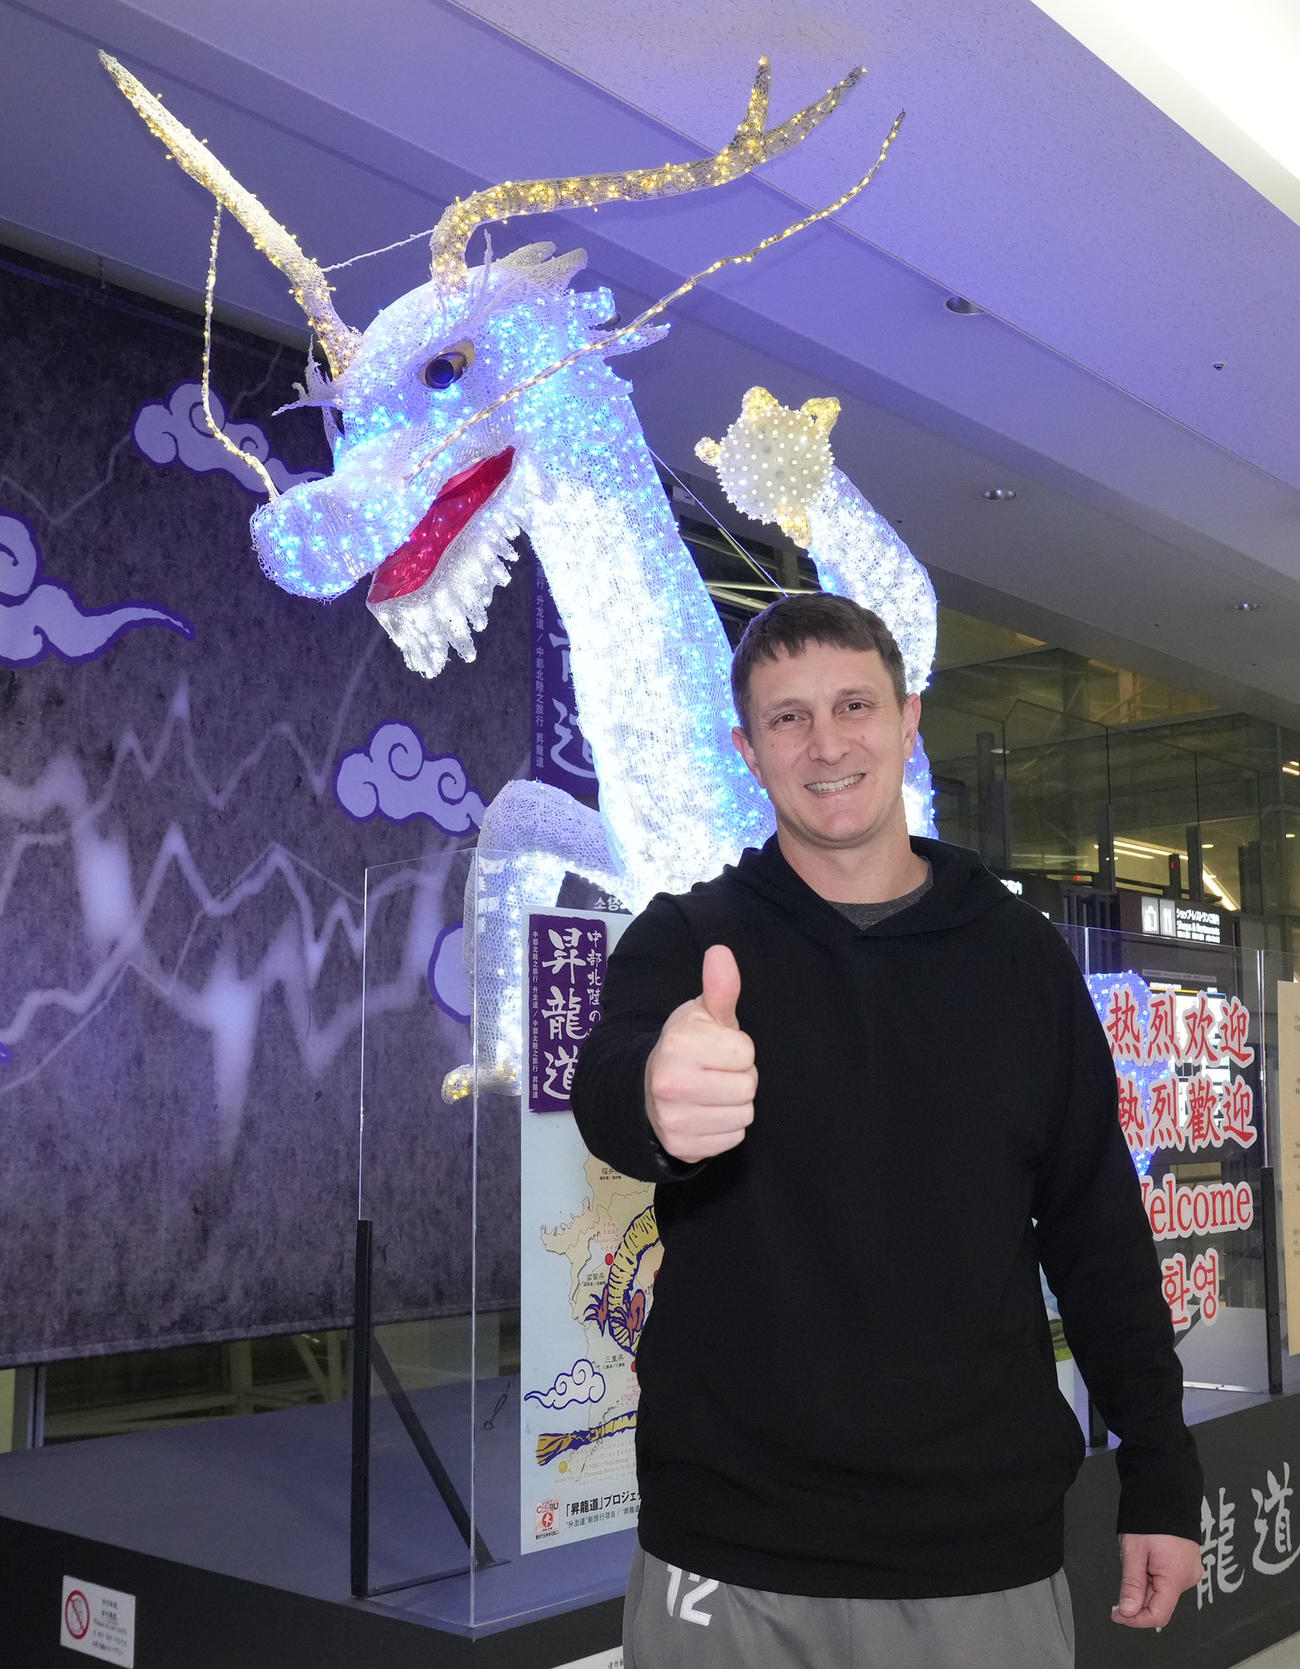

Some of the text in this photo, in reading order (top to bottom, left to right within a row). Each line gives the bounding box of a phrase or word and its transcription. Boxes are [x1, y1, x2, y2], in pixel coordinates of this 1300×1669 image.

[541, 927, 587, 1100] 昇龍道
[587, 930, 602, 1037] 中部北陸の
[1106, 990, 1252, 1062] 热烈欢迎
[1117, 1077, 1255, 1147] 熱烈歡迎
[1163, 1254, 1217, 1325] 환영
[1156, 1462, 1300, 1632] 龍道
[667, 1564, 719, 1627] 12
